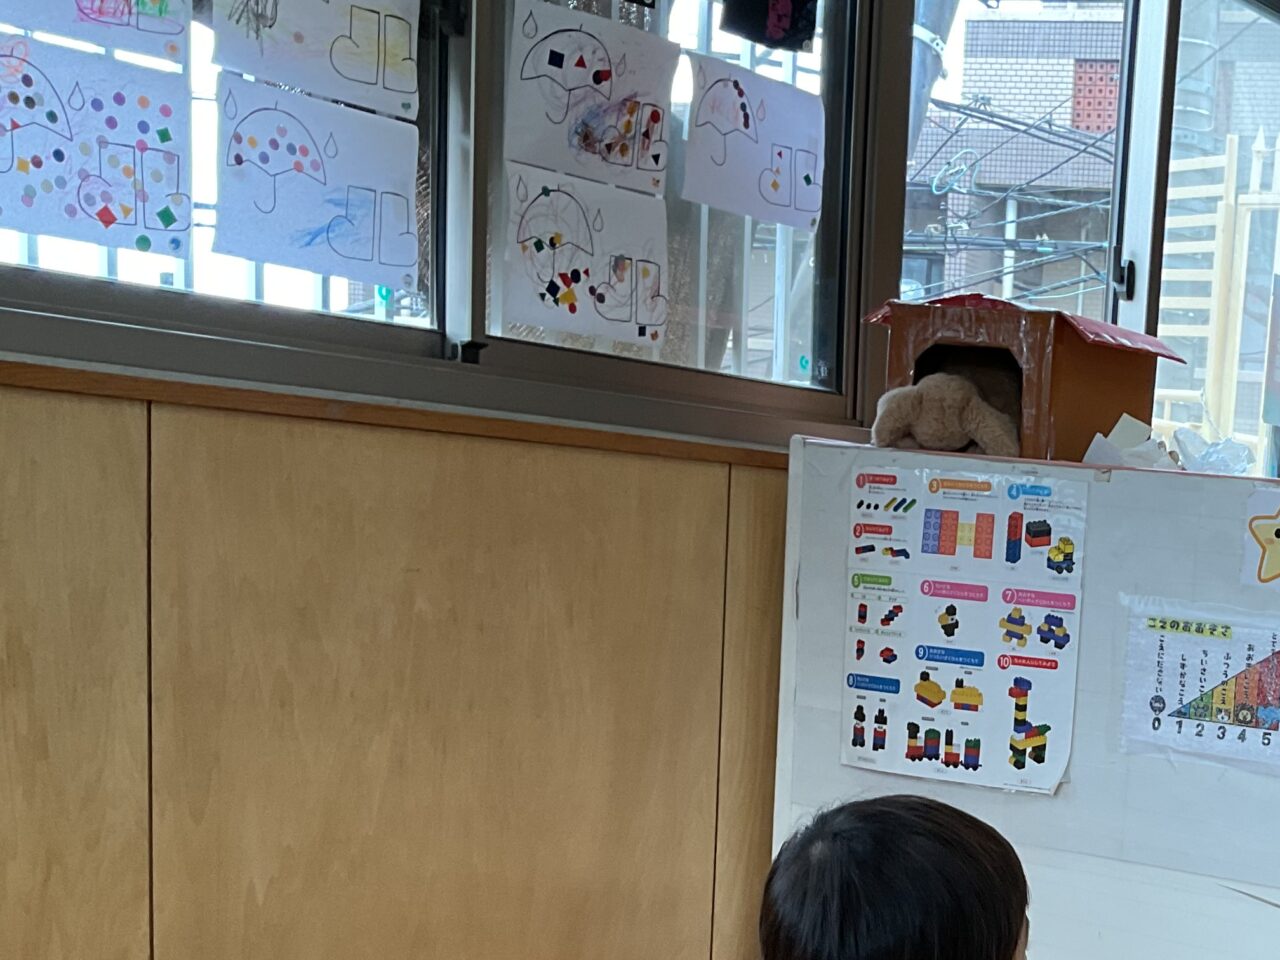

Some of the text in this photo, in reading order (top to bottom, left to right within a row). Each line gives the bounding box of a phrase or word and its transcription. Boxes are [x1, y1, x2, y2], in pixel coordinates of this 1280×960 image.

[1147, 617, 1231, 637] こえのおおきさ
[1220, 652, 1232, 705] ふつうのこえ
[1151, 716, 1162, 731] 0
[1175, 720, 1183, 734] 1
[1195, 723, 1205, 737] 2
[1216, 725, 1227, 740] 3
[1237, 729, 1247, 743] 4
[1261, 732, 1272, 746] 5
